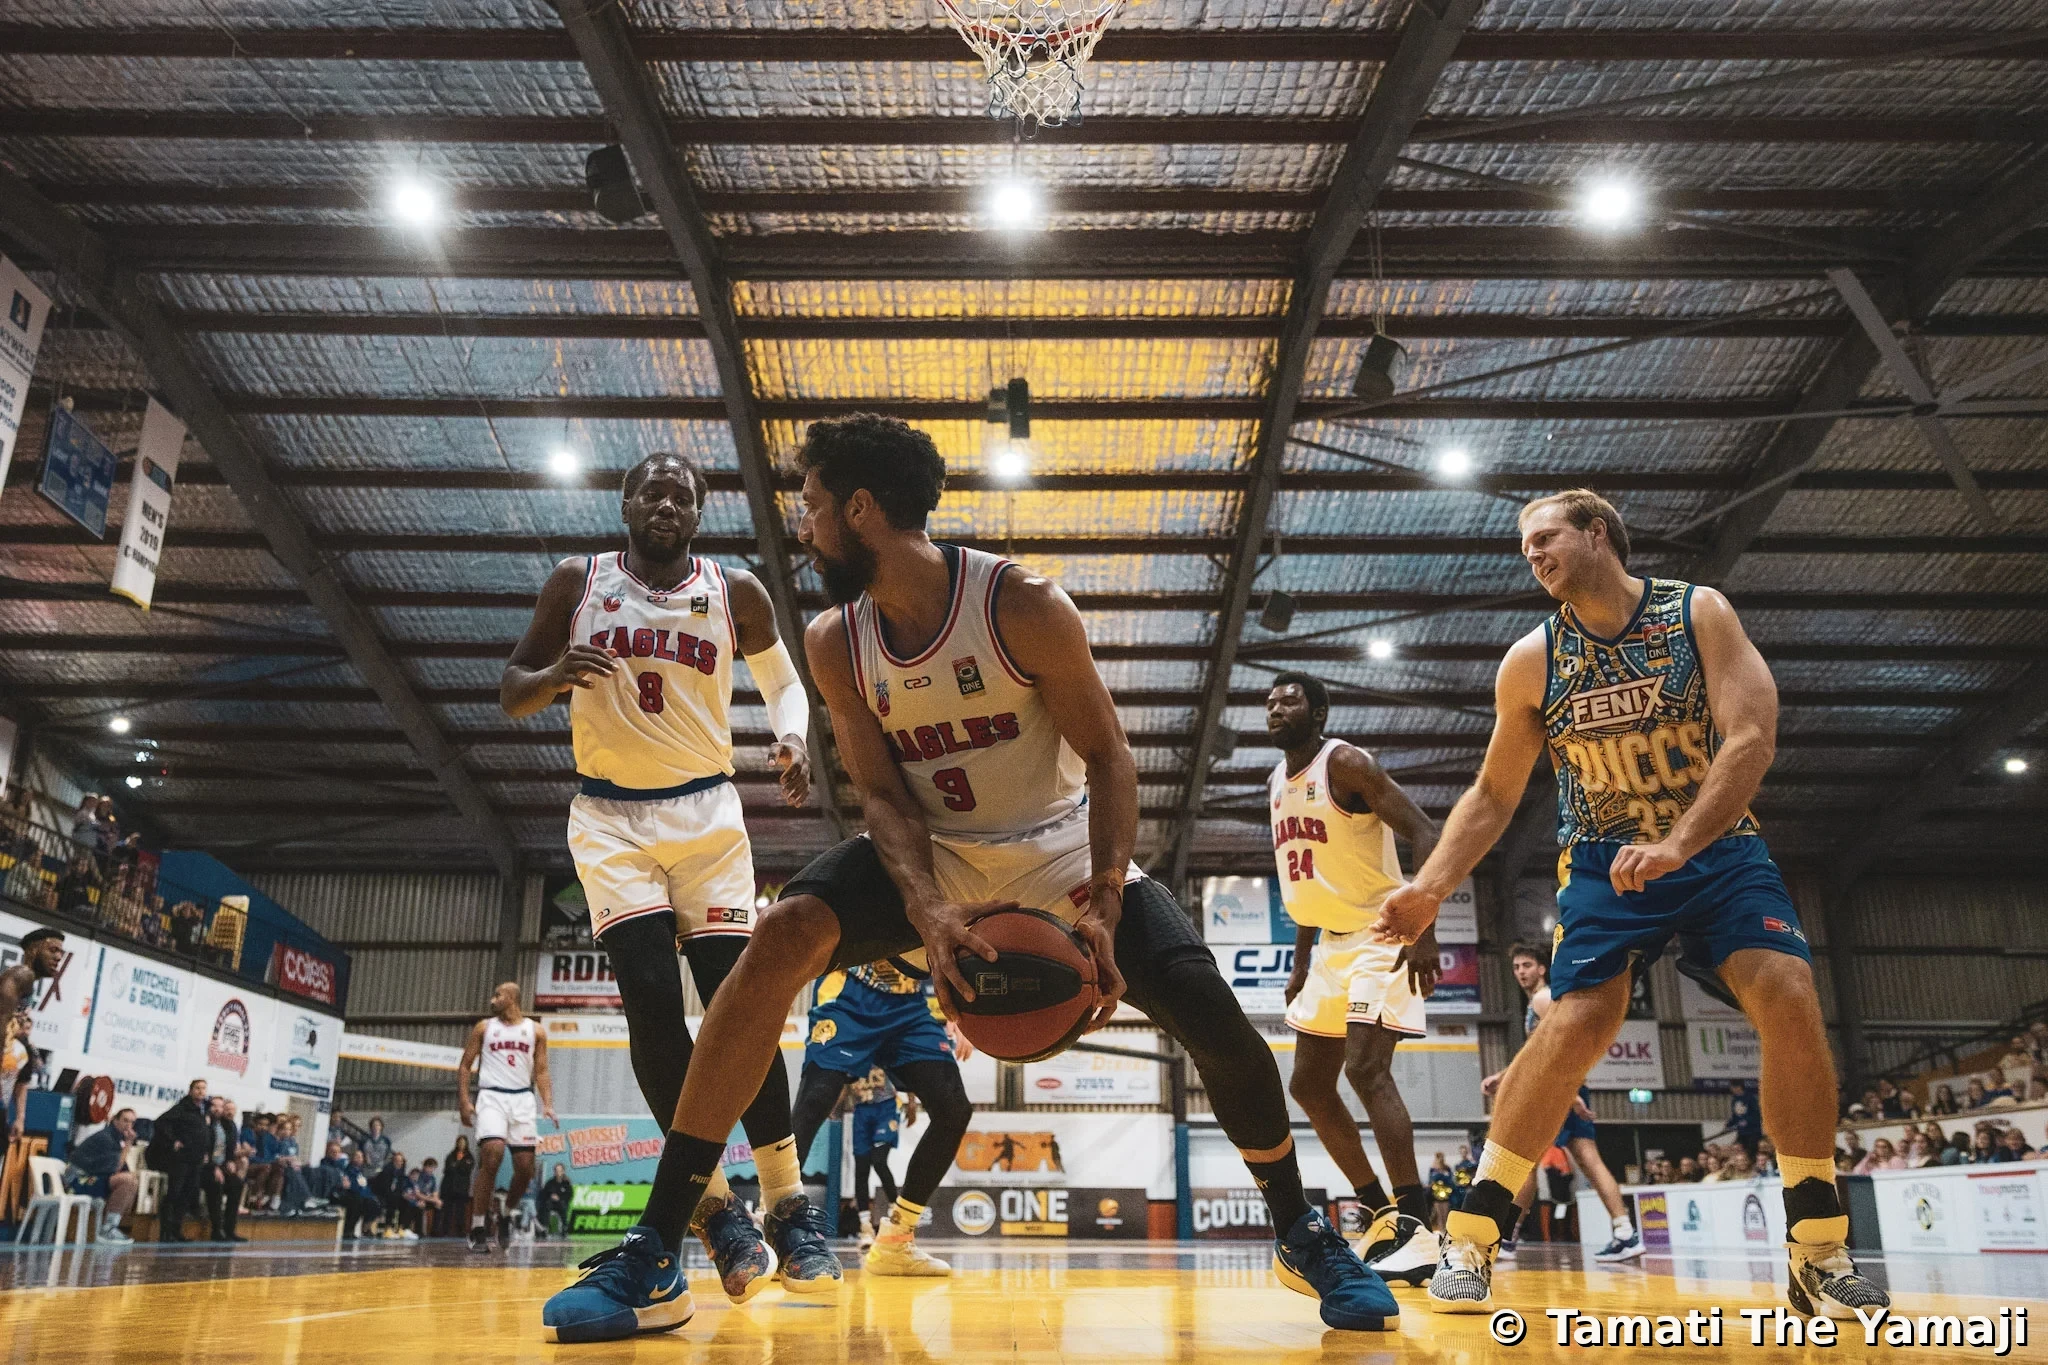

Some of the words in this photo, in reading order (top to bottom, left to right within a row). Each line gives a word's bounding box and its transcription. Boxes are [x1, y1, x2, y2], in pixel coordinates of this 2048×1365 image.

[1649, 647, 1669, 658] ONE
[637, 671, 664, 714] 8
[961, 680, 982, 693] ONE
[1569, 674, 1672, 732] FENIX
[932, 766, 977, 813] 9
[1287, 848, 1314, 882] 24
[734, 910, 748, 919] ONE
[132, 967, 180, 996] MITCHELL
[284, 951, 330, 992] coles
[139, 990, 179, 1015] BROWN
[593, 1024, 628, 1034] Wome
[568, 1126, 627, 1146] YOURSELF
[572, 1145, 623, 1166] RESPECT
[626, 1140, 661, 1159] YOUR
[690, 1174, 712, 1184] PUM
[573, 1187, 625, 1215] Kayo
[1000, 1190, 1069, 1222] ONE
[1192, 1199, 1275, 1232] COUR
